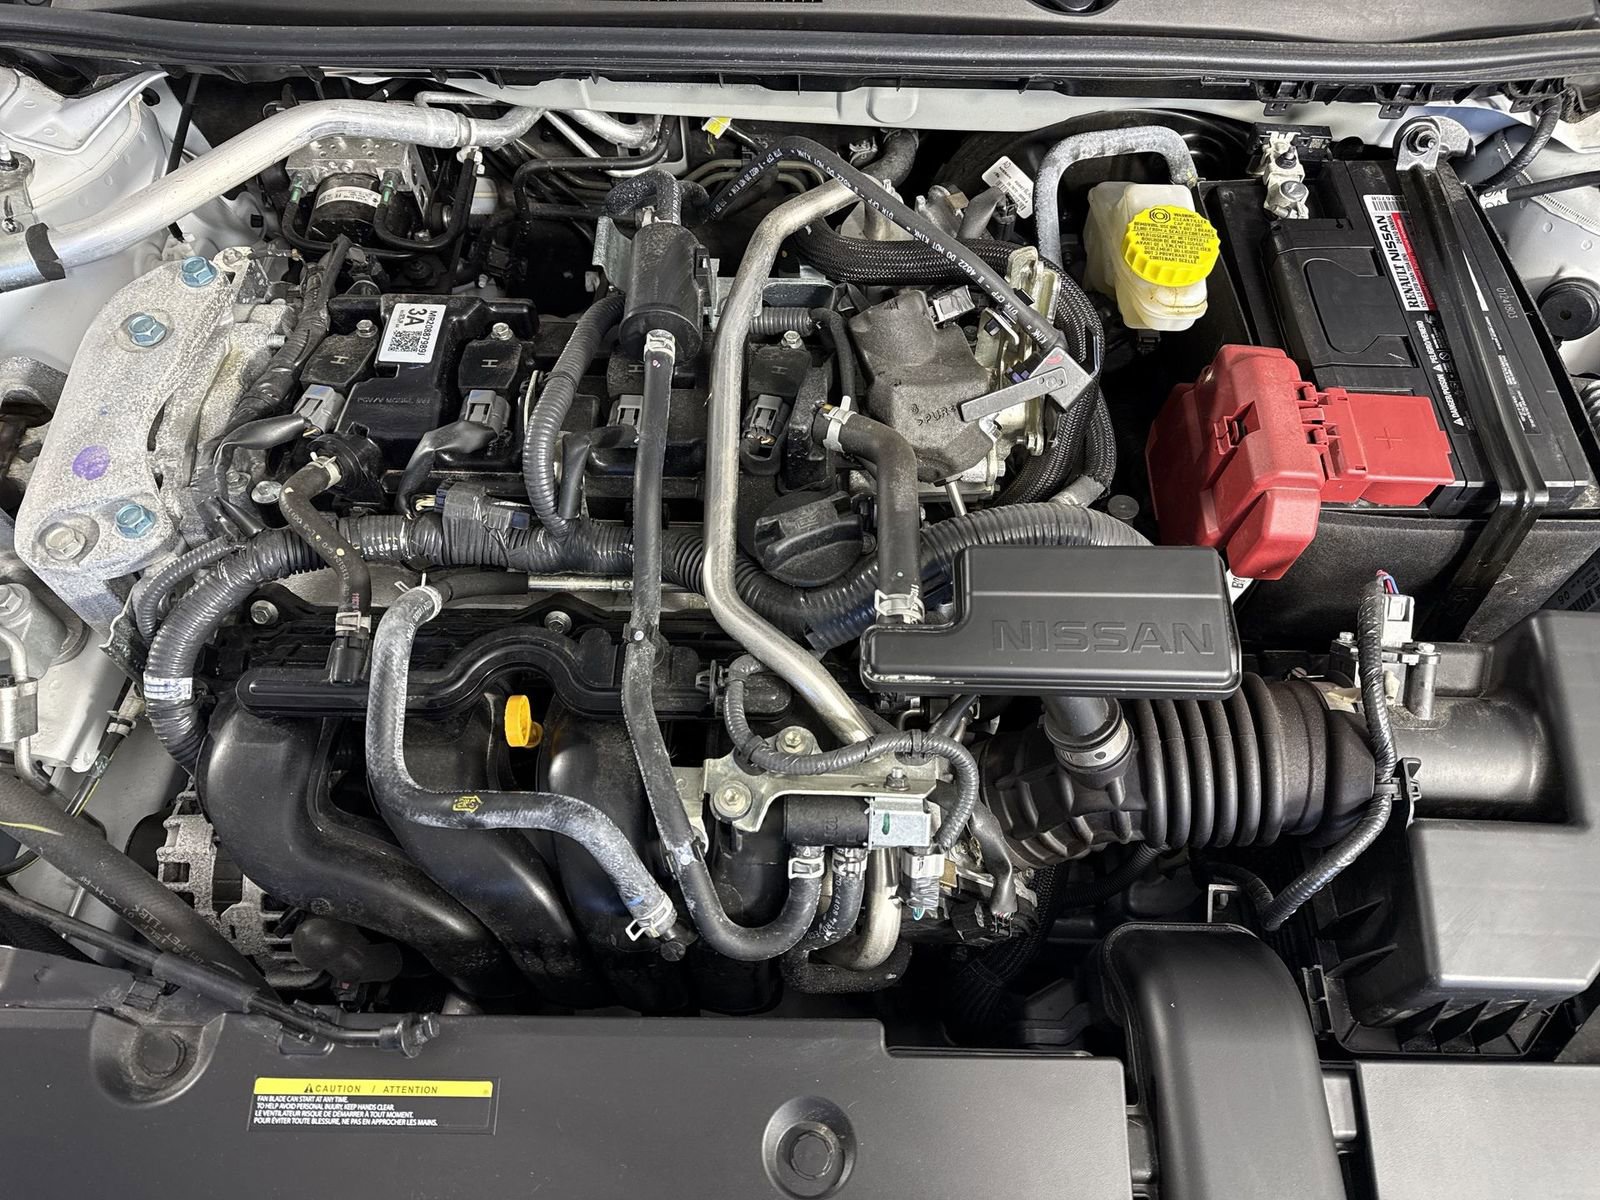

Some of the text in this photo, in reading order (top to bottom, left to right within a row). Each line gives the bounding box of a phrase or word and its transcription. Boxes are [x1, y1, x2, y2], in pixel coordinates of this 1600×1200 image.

[1374, 215, 1402, 262] NISSAN
[1393, 264, 1421, 308] RENAULT
[404, 308, 428, 326] 3A
[1415, 320, 1439, 364] PELIGRO/VENENO
[1436, 373, 1460, 418] DANGER/POISON
[992, 619, 1215, 655] NISSAN
[315, 1085, 361, 1093] CAUTION
[382, 1086, 438, 1094] ATTENTION
